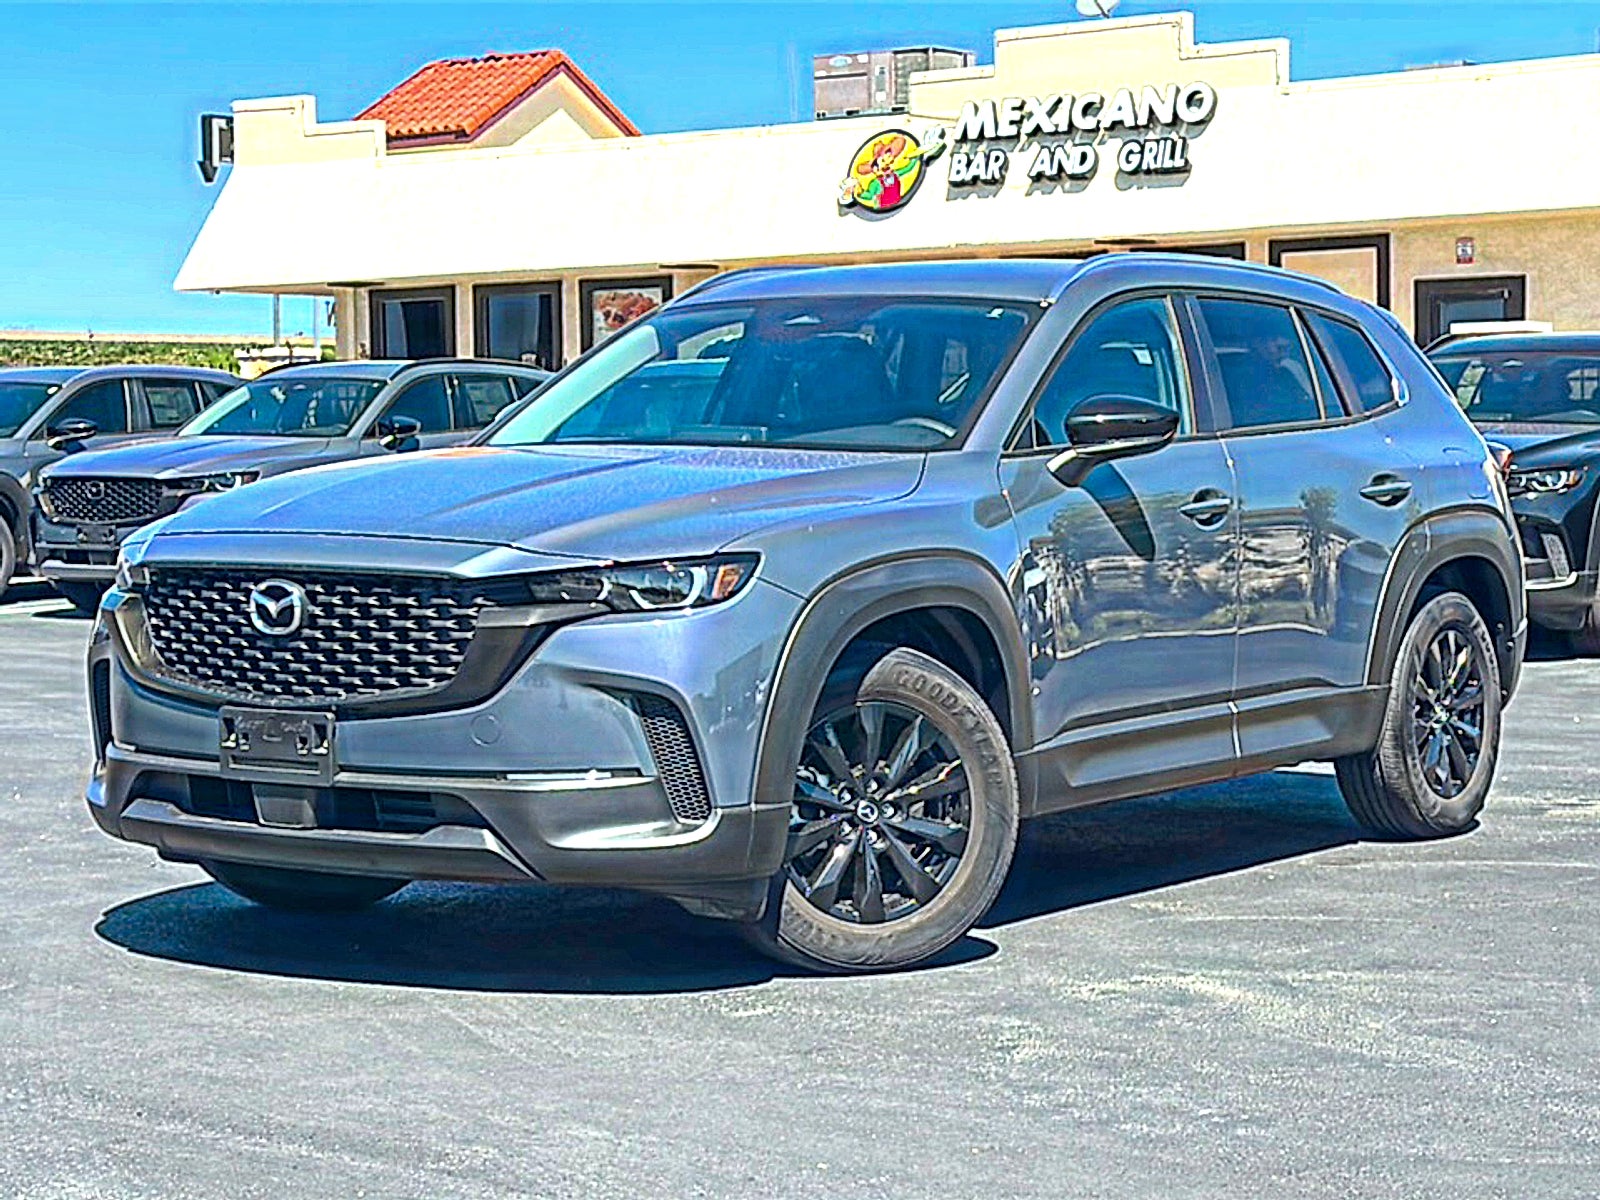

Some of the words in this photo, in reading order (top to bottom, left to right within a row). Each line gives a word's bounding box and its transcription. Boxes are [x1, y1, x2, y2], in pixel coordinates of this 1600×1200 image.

[953, 81, 1216, 141] MEXICANO
[949, 149, 1006, 183] BAR
[1028, 142, 1096, 178] AND
[1118, 137, 1187, 173] GRILL
